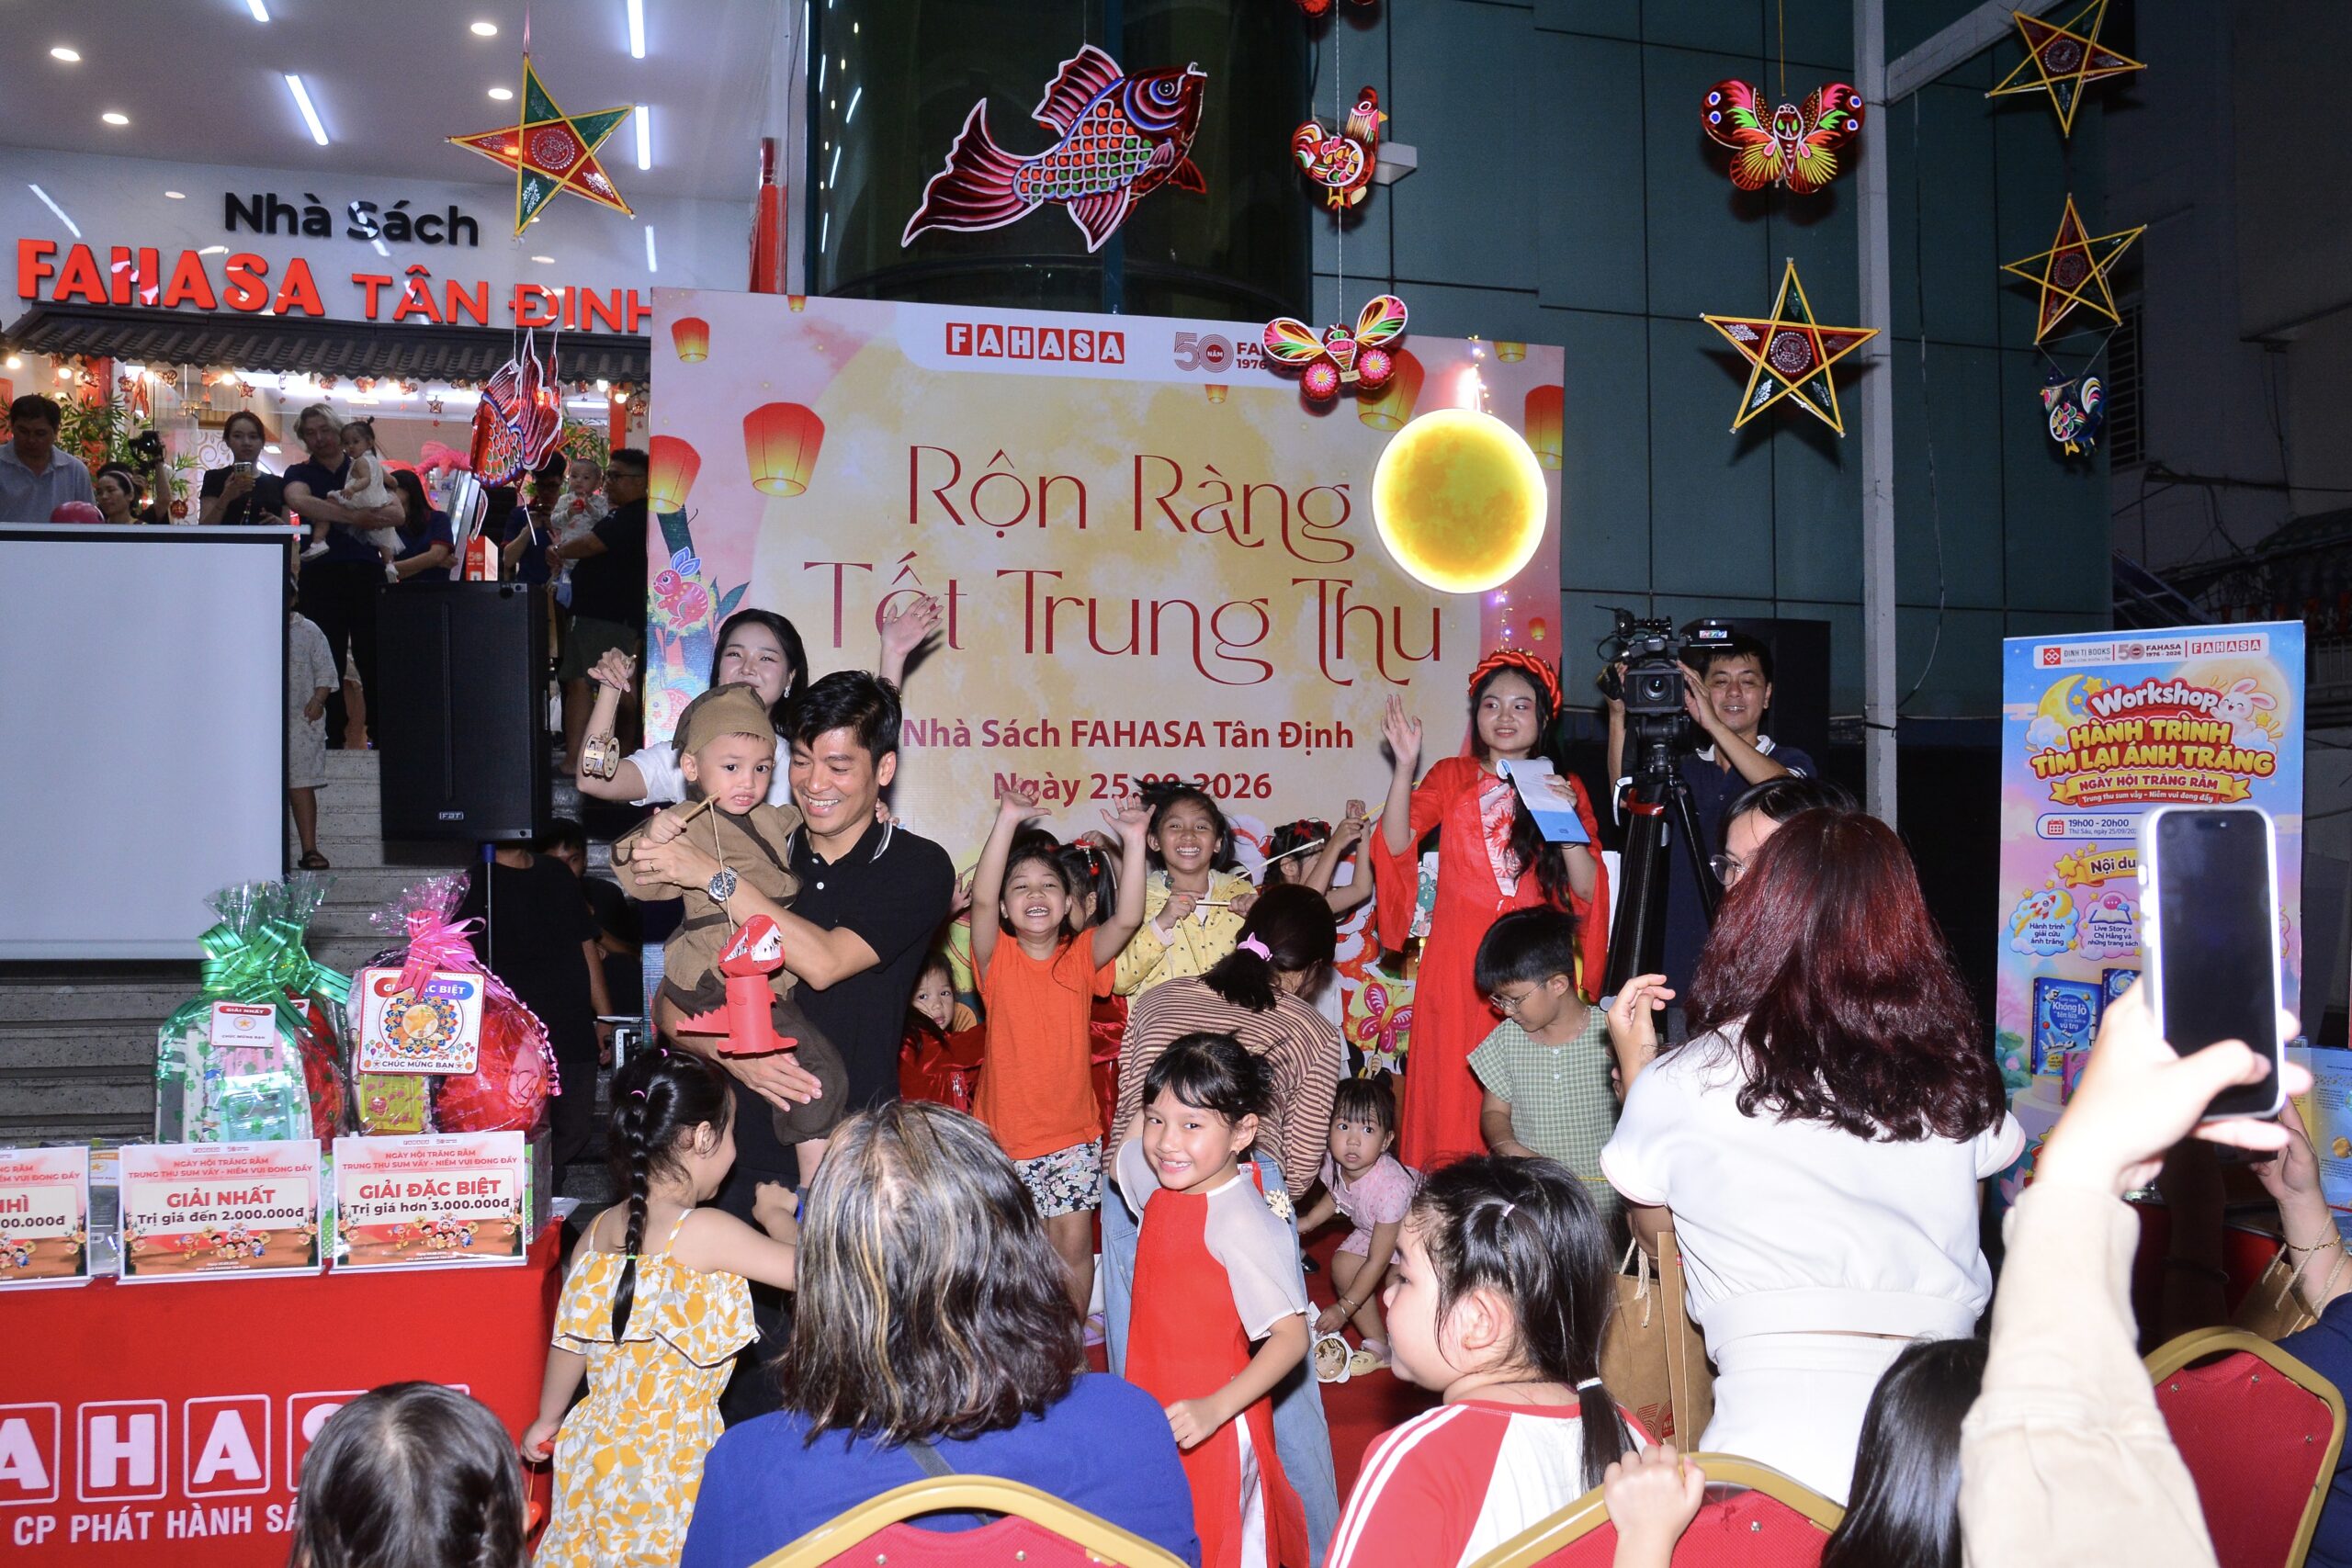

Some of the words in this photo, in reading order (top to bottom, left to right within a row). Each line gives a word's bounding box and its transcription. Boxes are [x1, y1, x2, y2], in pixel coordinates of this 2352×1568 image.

[225, 191, 332, 238] Nhà
[346, 198, 479, 246] Sách
[17, 238, 325, 317] FAHASA
[352, 265, 490, 325] TÂN
[947, 323, 1124, 363] FAHASA
[1174, 332, 1234, 373] 50
[1206, 349, 1225, 359] NĂM
[908, 445, 1089, 538] Rộn
[1133, 453, 1355, 564] Ràng
[803, 550, 967, 650] Tết
[996, 569, 1274, 686] Trung
[1291, 577, 1442, 686] Thu
[2087, 648, 2111, 656] BOOKS
[2146, 643, 2182, 651] FAHASA
[2192, 639, 2261, 655] FAHASA
[2091, 682, 2219, 717] Workshop
[903, 717, 970, 748] Nhà
[982, 717, 1061, 748] Sách
[1071, 719, 1206, 749] FAHASA
[1214, 720, 1271, 749] Tân
[1278, 719, 1354, 755] Định
[2069, 719, 2143, 750] HÀNH
[2149, 715, 2231, 744] TRÌNH
[2030, 749, 2077, 778] TÌM
[2080, 746, 2120, 771] LẠI
[2122, 740, 2177, 765] ÁNH
[2181, 745, 2274, 774] TRĂNG
[994, 772, 1081, 807] Ngày
[1090, 773, 1273, 800] 25.2026
[2079, 776, 2113, 792] NGÀY
[2116, 773, 2139, 787] HỘI
[2142, 773, 2187, 787] TRĂNG
[2189, 774, 2219, 789] RẰM
[2082, 795, 2103, 804] Trung
[2101, 819, 2130, 828] 20h00
[2090, 858, 2115, 874] Nội
[2118, 855, 2137, 869] du
[2030, 922, 2048, 931] Hành
[2109, 925, 2127, 933] Story
[439, 985, 466, 997] BIỆT
[407, 1059, 434, 1068] MỪNG
[435, 1062, 455, 1070] BẠN
[173, 1159, 198, 1168] NGÀY
[218, 1157, 248, 1166] TRĂNG
[386, 1150, 410, 1159] NGÀY
[427, 1150, 456, 1158] TRĂNG
[166, 1187, 210, 1208] GIẢI
[217, 1185, 276, 1206] NHẤT
[359, 1179, 401, 1200] GIẢI
[406, 1179, 451, 1201] ĐẶC
[456, 1177, 502, 1198] BIỆT
[351, 1203, 369, 1216] Trị
[374, 1201, 397, 1216] giá
[400, 1200, 428, 1213] hơn
[431, 1197, 511, 1211] 3.000.000đ
[1, 1215, 66, 1228] 00.000đ
[137, 1213, 158, 1227] Trị
[162, 1210, 185, 1226] giá
[189, 1209, 218, 1223] đến
[221, 1207, 305, 1221] 2.000.000đ
[14, 1515, 56, 1547] CP
[71, 1506, 154, 1543] PHÁT
[166, 1502, 253, 1540] HÀNH
